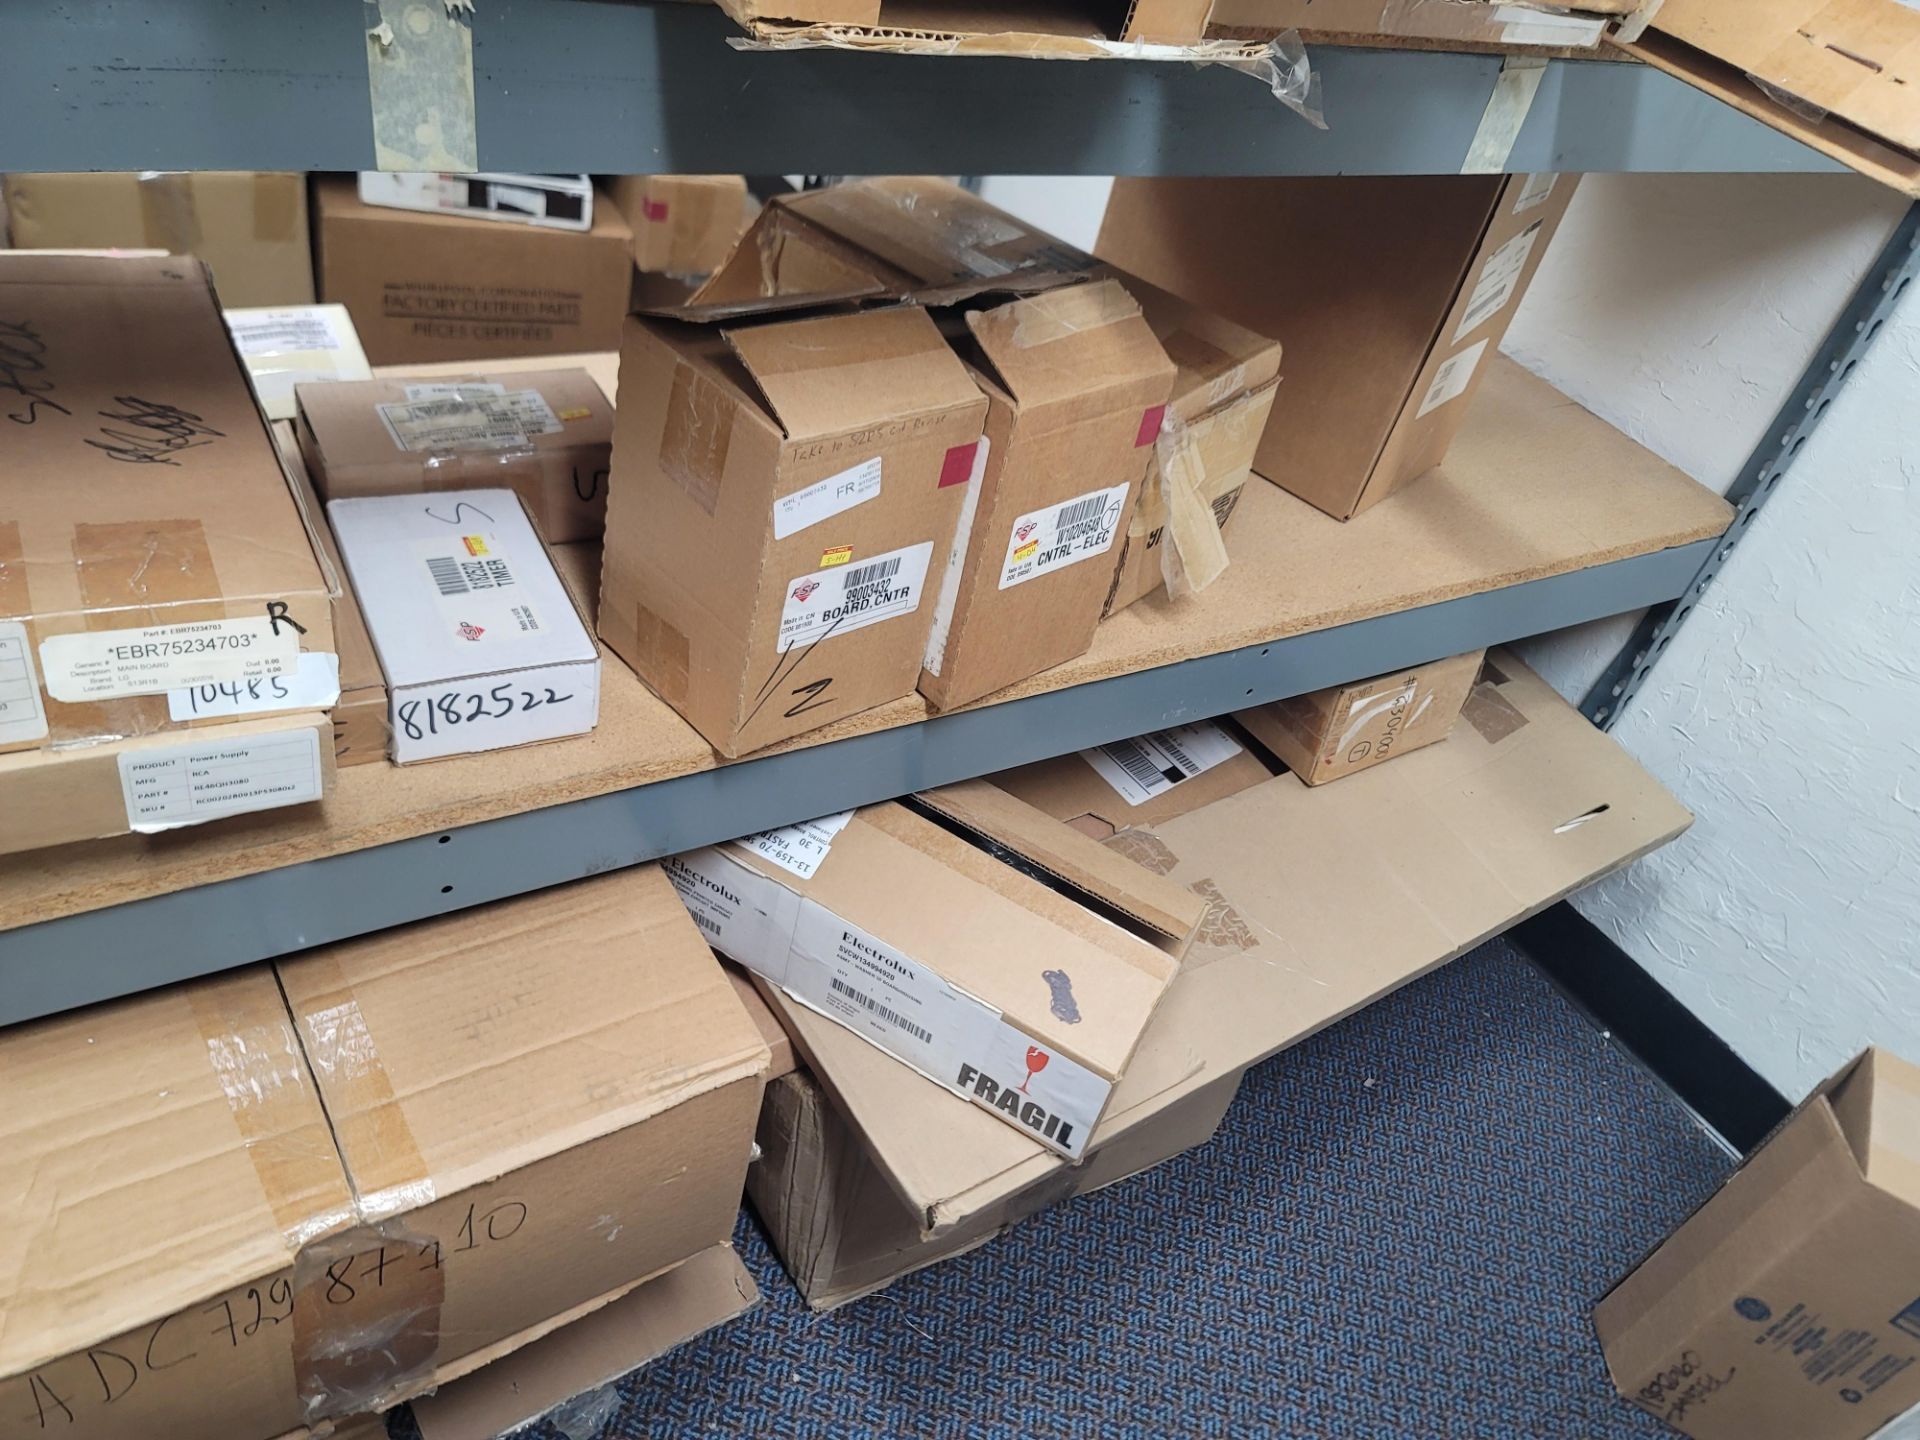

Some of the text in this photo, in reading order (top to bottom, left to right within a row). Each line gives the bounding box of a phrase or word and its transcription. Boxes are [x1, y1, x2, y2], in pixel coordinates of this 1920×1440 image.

[836, 481, 855, 499] FR
[1014, 522, 1038, 538] FSP
[486, 559, 515, 587] TIMER
[791, 582, 820, 599] FSP
[267, 601, 308, 636] R
[399, 683, 574, 740] 8182522
[759, 841, 812, 872] 13-159-70
[799, 838, 812, 848] 30
[671, 857, 742, 906] Electrolux
[842, 931, 917, 981] Electrolux
[956, 1062, 1074, 1150] FRAGIL
